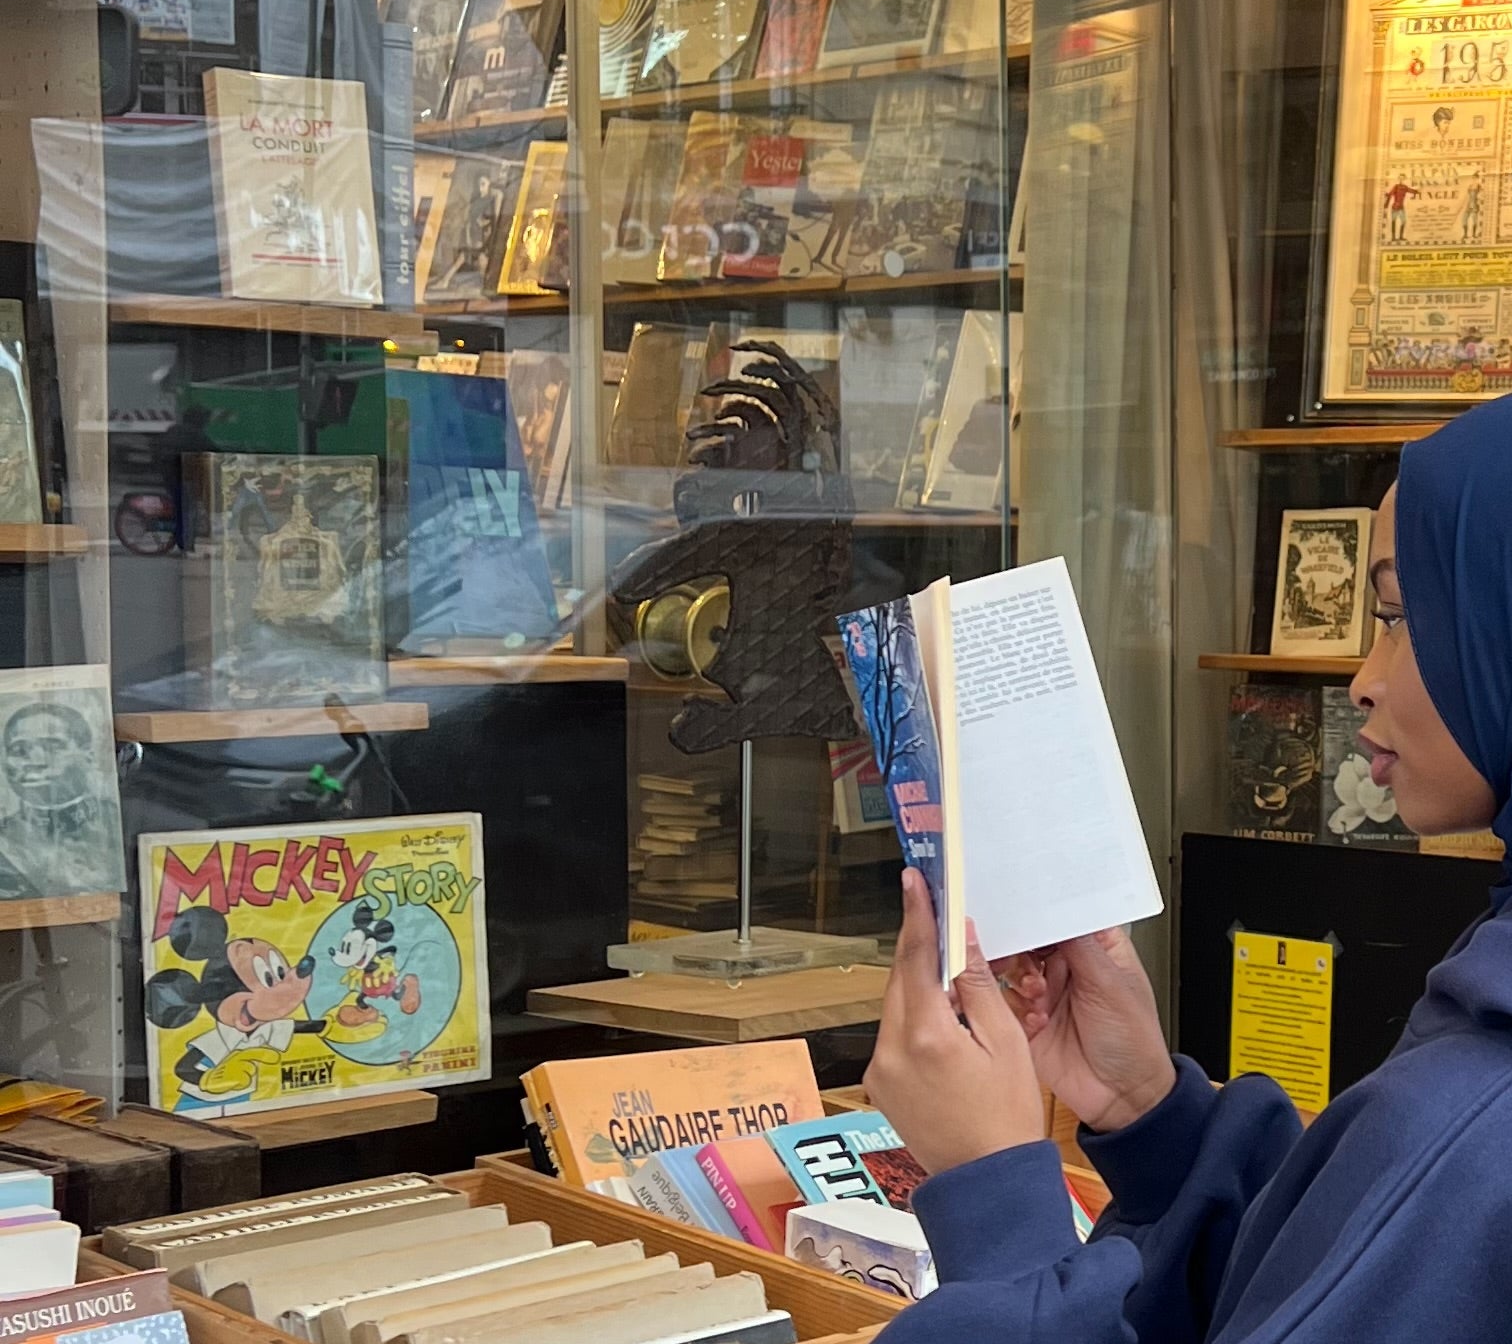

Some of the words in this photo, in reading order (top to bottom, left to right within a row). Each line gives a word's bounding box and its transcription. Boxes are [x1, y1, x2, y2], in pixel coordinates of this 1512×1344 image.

[1406, 16, 1443, 34] LES
[240, 113, 264, 132] LA
[273, 117, 334, 138] MORT
[252, 136, 326, 154] CONDUIT
[393, 166, 409, 227] eiffel
[396, 241, 409, 285] tour
[1260, 829, 1315, 844] CORBETT
[151, 835, 378, 943] MICKEY
[363, 861, 482, 921] STORY
[281, 1060, 335, 1091] MICKEY
[422, 1058, 477, 1074] PANINI
[612, 1089, 654, 1119] JEAN
[609, 1110, 724, 1158] GAUDAIRE
[844, 1130, 877, 1153] The
[700, 1155, 724, 1192] PIN
[651, 1170, 691, 1222] Belgique
[75, 1288, 137, 1322] INOUÉ
